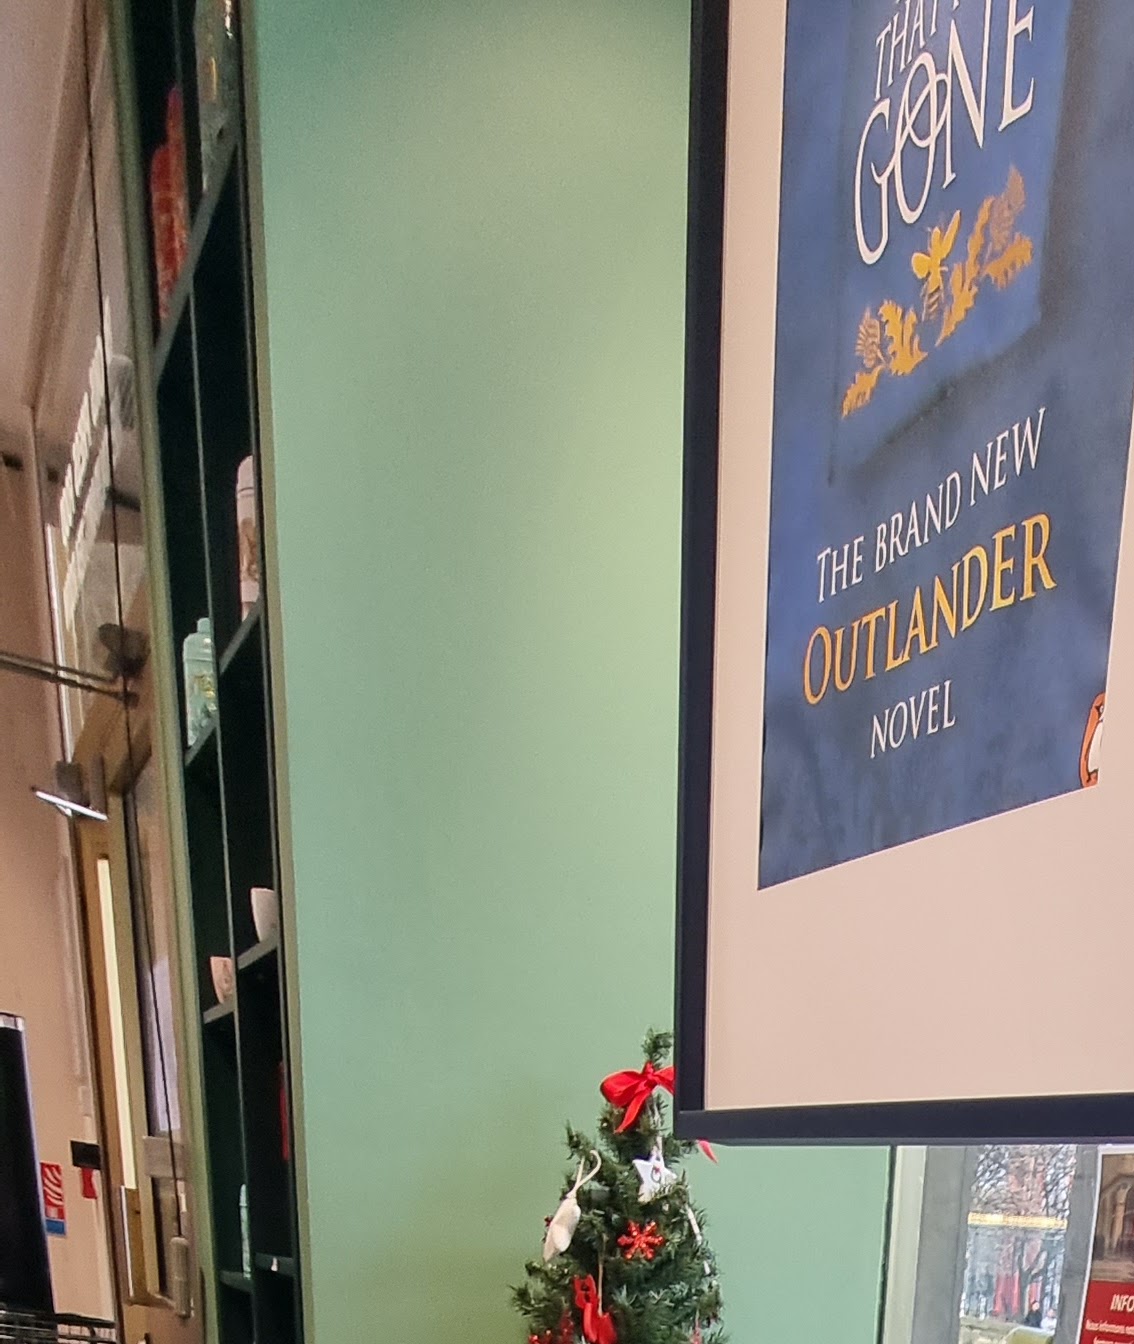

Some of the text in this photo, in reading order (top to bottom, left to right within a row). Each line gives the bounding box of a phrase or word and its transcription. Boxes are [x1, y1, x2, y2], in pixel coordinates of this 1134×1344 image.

[854, 0, 1035, 265] GONE
[816, 407, 1048, 604] THE BRAND NEW
[802, 511, 1058, 706] OUTLANDER
[870, 679, 957, 761] NOVEL
